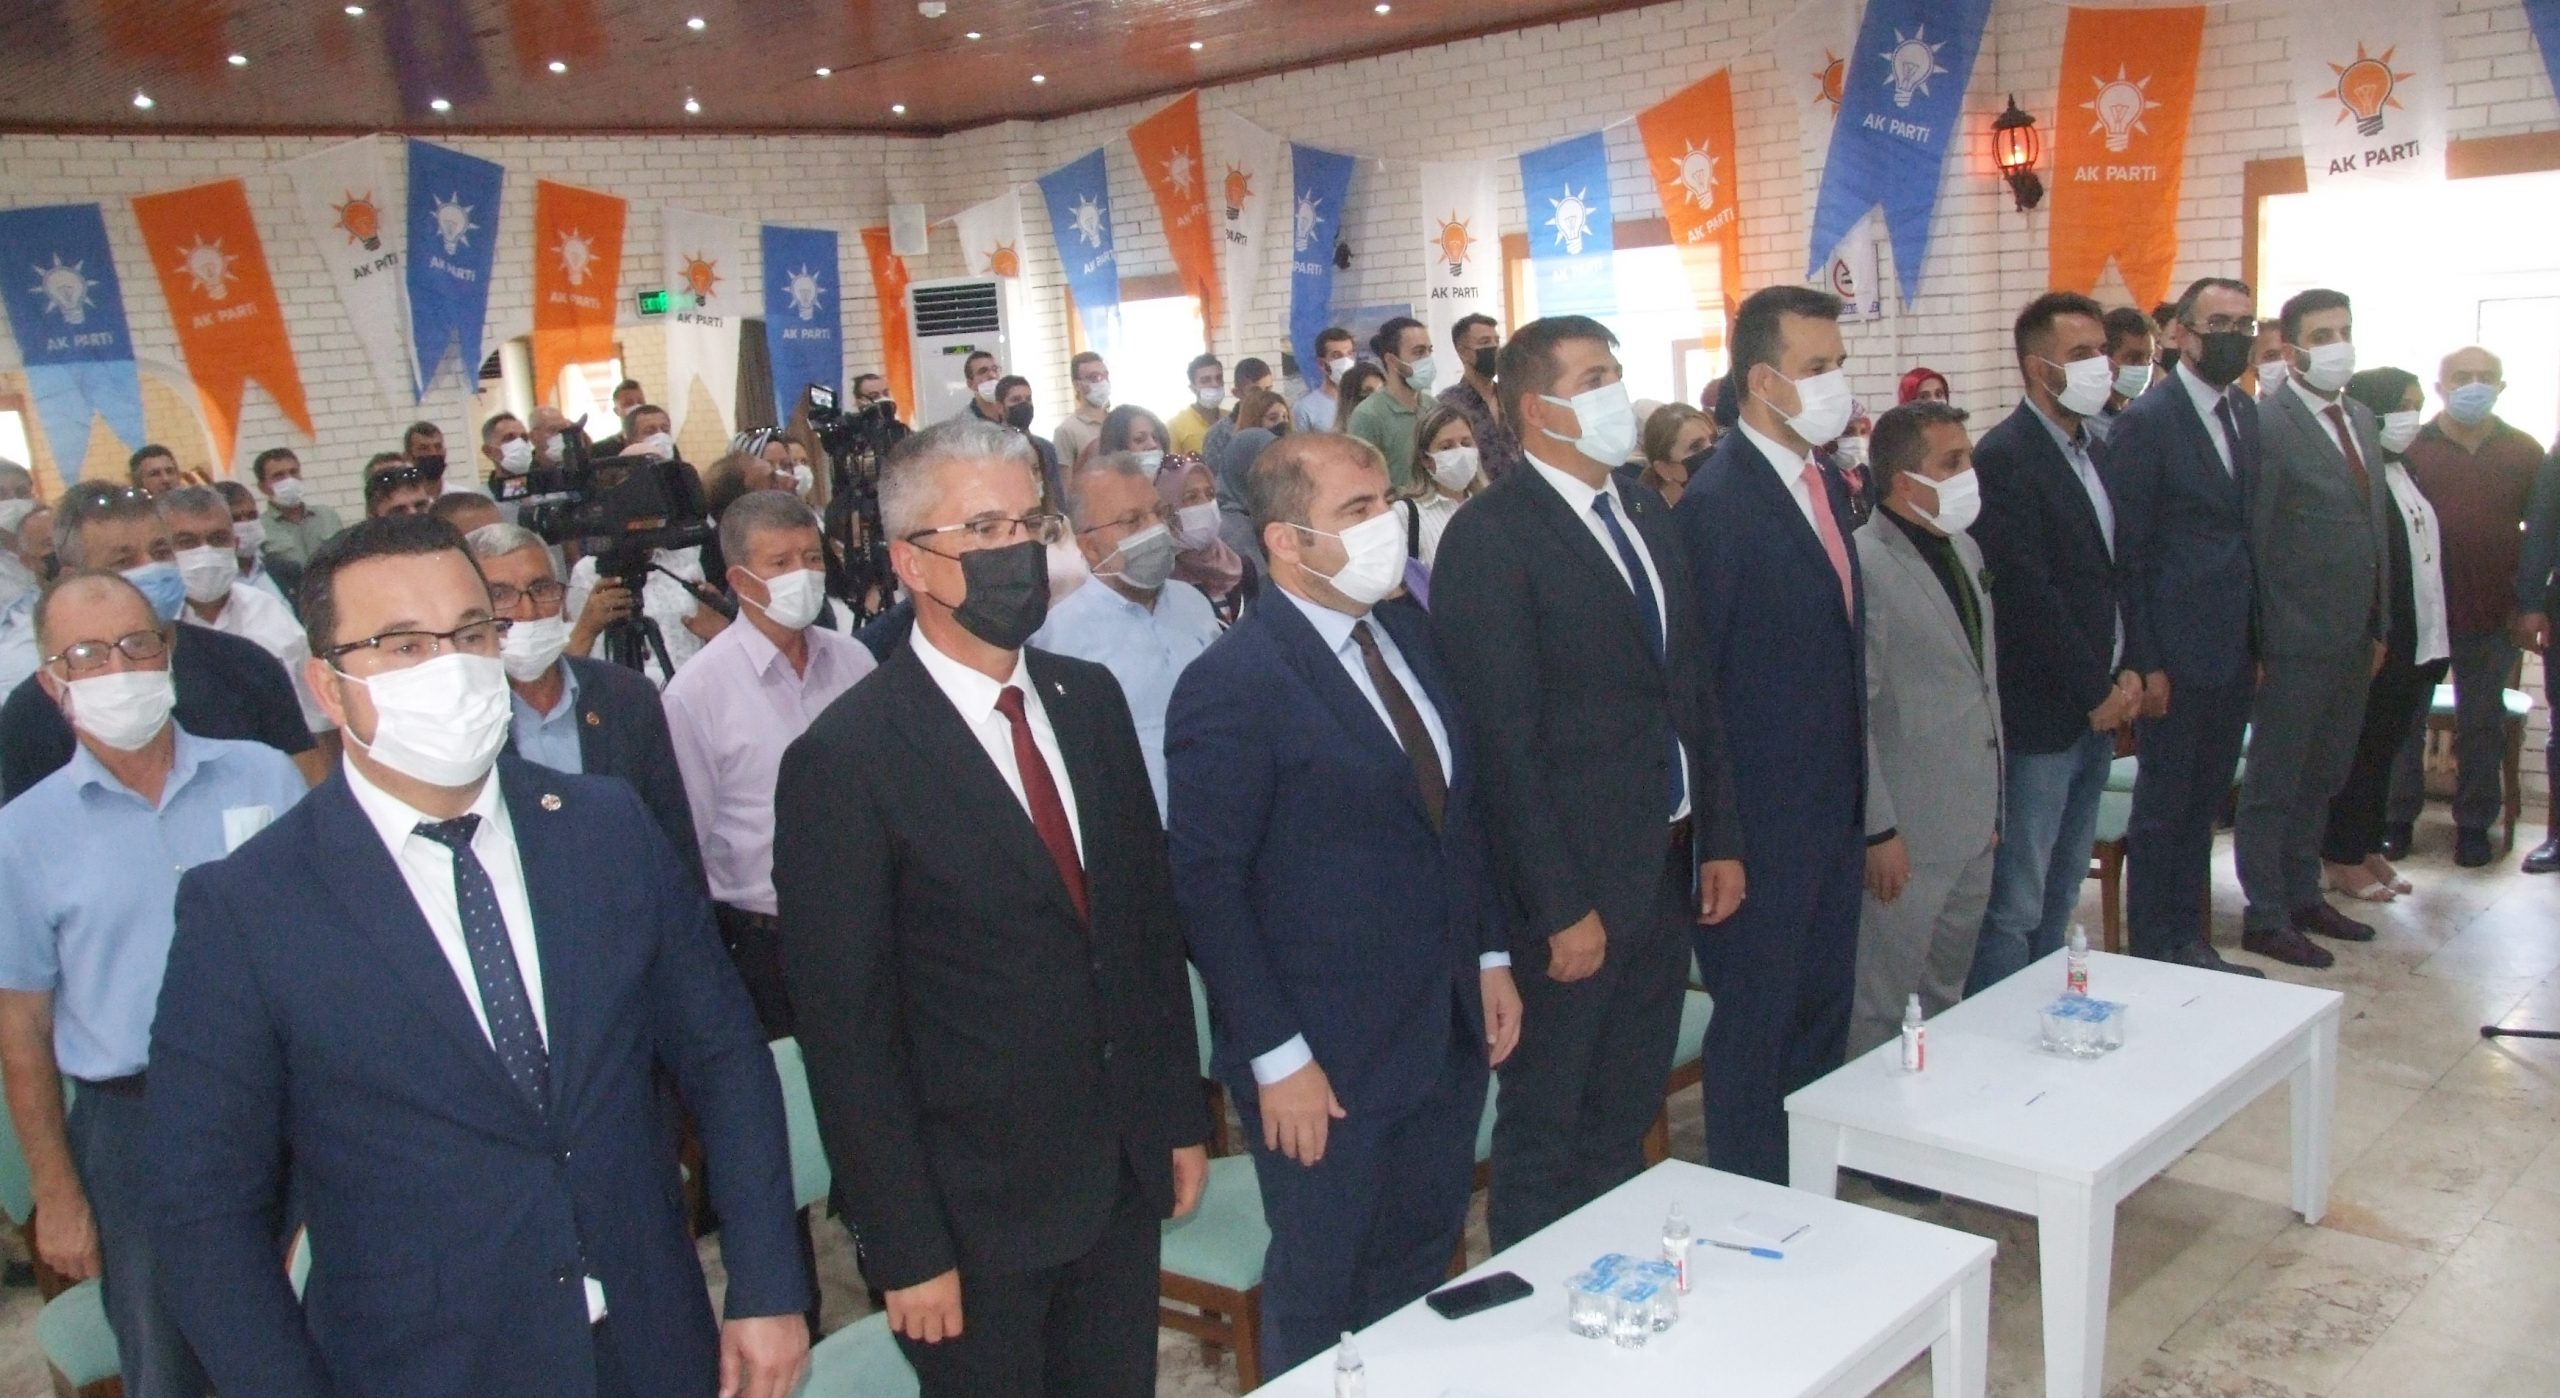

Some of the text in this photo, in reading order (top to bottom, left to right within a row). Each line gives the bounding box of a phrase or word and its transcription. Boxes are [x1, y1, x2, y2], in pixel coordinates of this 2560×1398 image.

[1862, 112, 1886, 131] AK
[2328, 154, 2357, 176] AK
[2074, 165, 2100, 182] AK
[1687, 224, 1705, 244] AK
[353, 264, 373, 280] AK
[1431, 286, 1448, 299] AK
[677, 313, 692, 323] AK
[783, 327, 798, 339] AK
[47, 335, 70, 351] AK
